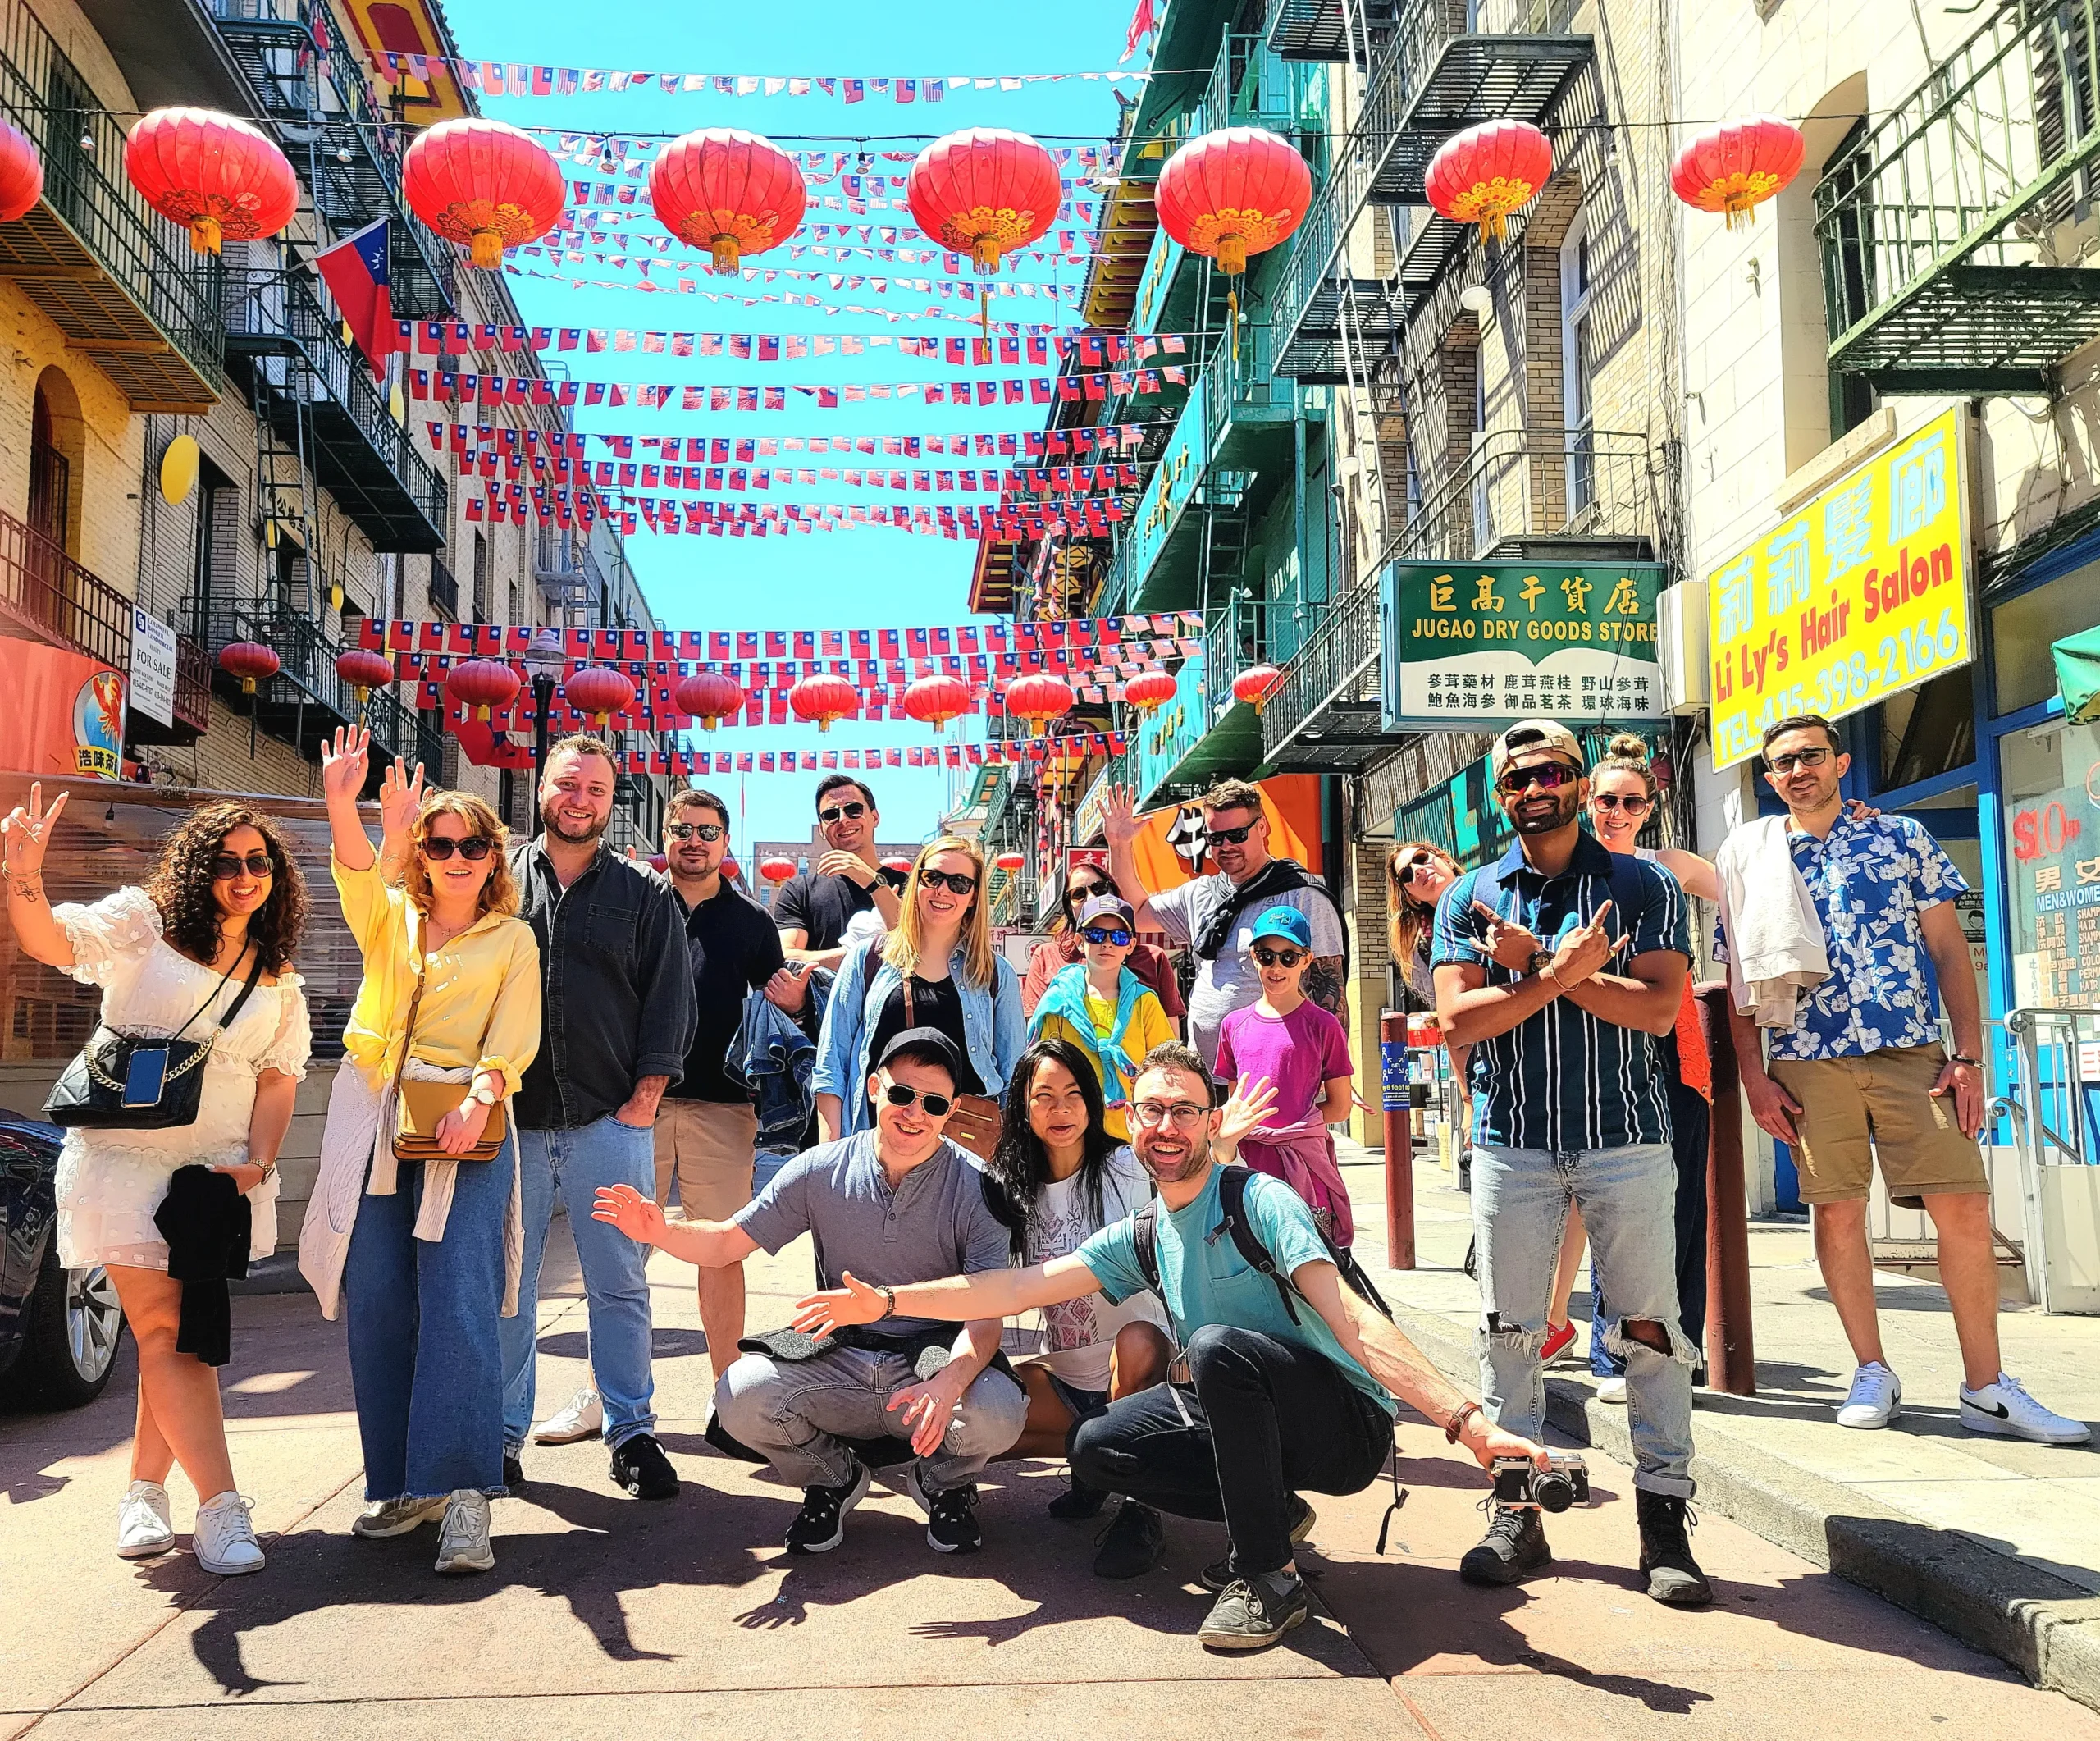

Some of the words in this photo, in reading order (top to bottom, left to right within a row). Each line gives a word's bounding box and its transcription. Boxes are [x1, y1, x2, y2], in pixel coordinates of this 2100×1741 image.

[1412, 619, 1475, 639] JUGAO
[1483, 619, 1520, 640] DRY
[1527, 620, 1591, 641] GOODS
[1599, 621, 1657, 642] STORE
[1714, 651, 1732, 704] Li
[1741, 629, 1789, 696] Ly's
[1801, 588, 1851, 660] Hair
[1864, 542, 1952, 624] Salon
[136, 647, 152, 669] FOR
[153, 658, 171, 680] SALE
[2077, 919, 2097, 931] HAIR
[2079, 944, 2093, 955] OIL
[2080, 979, 2098, 992] HAIR
